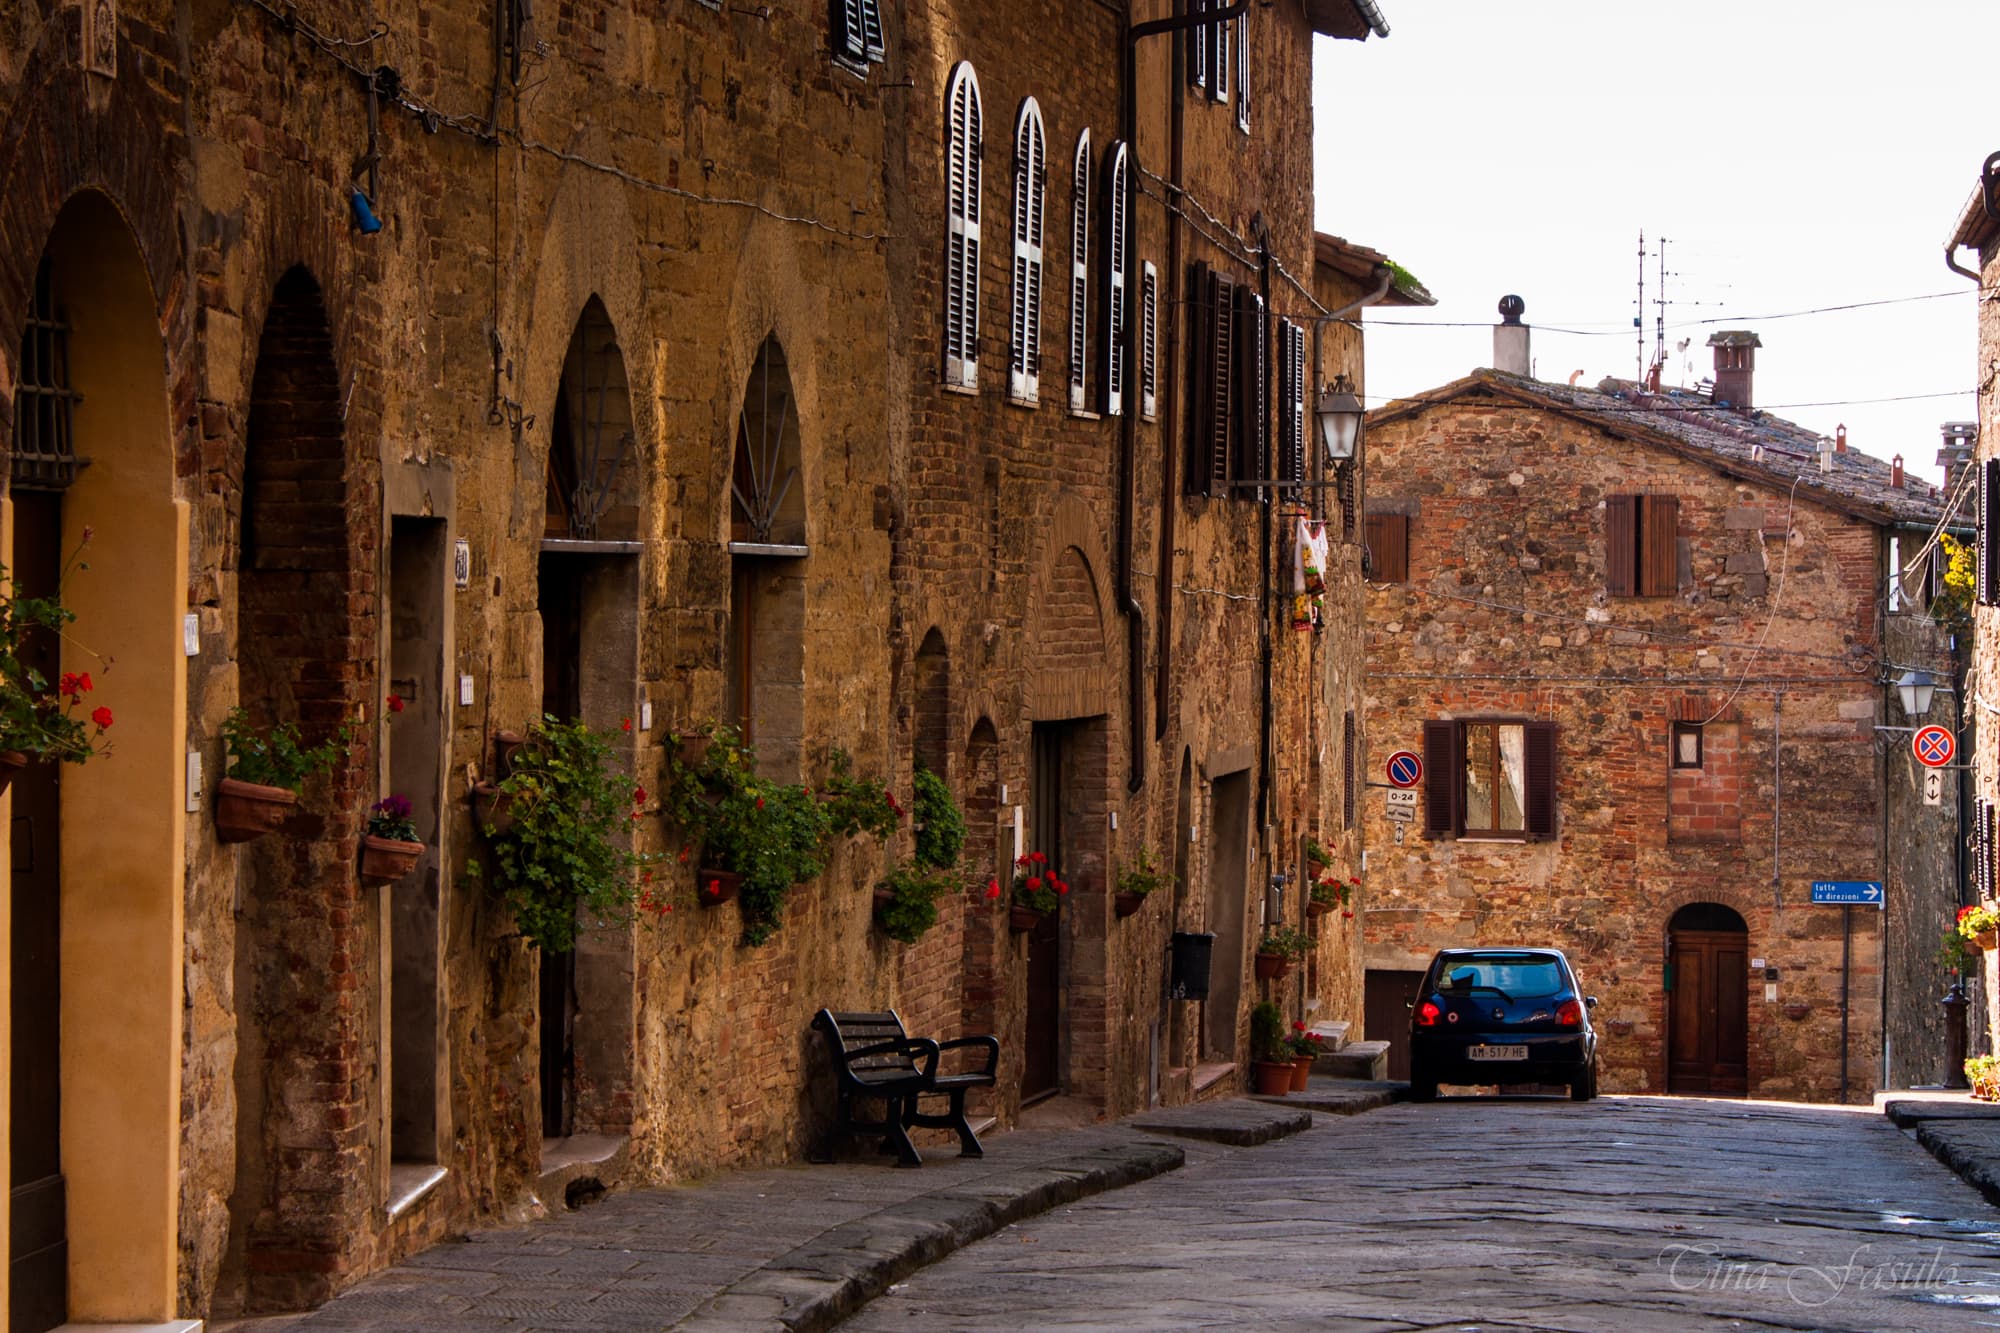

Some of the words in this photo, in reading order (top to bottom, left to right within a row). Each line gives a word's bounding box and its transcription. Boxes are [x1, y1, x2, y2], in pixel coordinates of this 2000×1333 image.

[1815, 884, 1836, 892] tutte
[1815, 892, 1823, 900] le
[1826, 892, 1859, 900] direzioni
[1490, 1047, 1509, 1058] 517
[1512, 1047, 1526, 1058] HE
